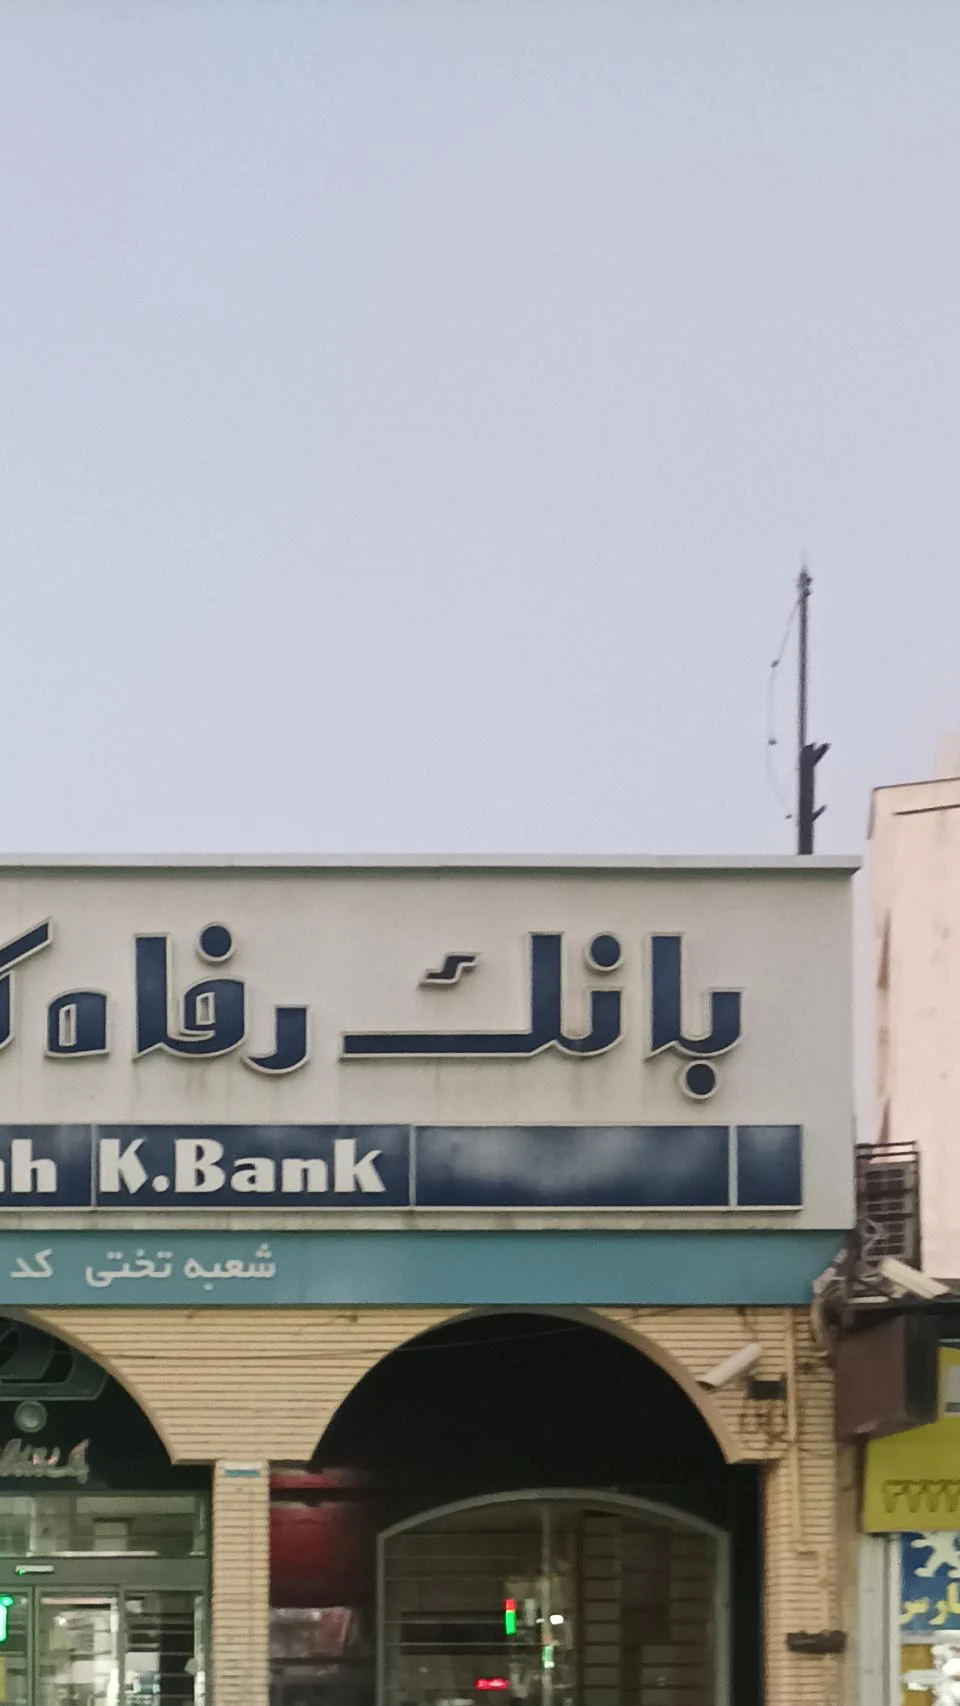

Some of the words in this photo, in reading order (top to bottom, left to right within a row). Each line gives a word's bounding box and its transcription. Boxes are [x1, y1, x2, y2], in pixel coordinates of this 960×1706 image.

[44, 919, 310, 1075] رفاه
[99, 1137, 386, 1194] K.Bank
[9, 1248, 53, 1278] کد
[84, 1249, 173, 1288] تختی
[183, 1243, 276, 1291] شعبه
